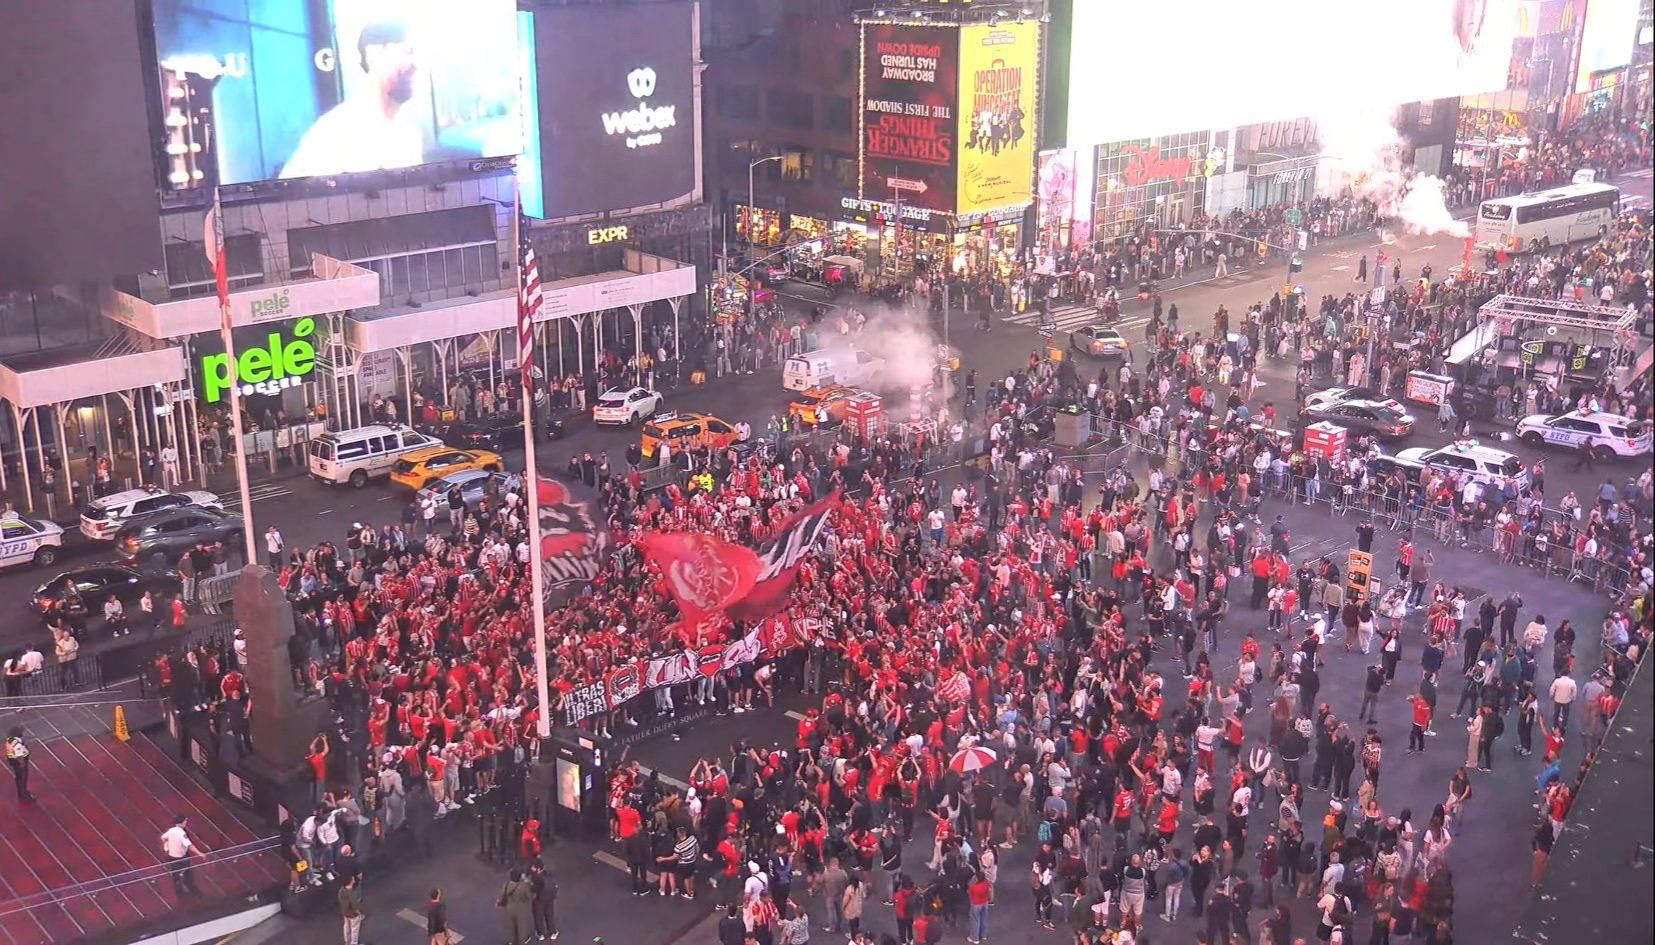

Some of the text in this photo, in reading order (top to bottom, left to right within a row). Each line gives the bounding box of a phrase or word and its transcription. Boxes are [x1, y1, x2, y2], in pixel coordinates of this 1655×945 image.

[881, 55, 936, 70] HAS TURNED
[882, 67, 934, 82] BROADWAY
[974, 66, 1022, 94] OPERATION
[601, 102, 676, 135] webex
[866, 99, 951, 119] THE FIRST SHADOW
[880, 115, 938, 140] THINGS
[867, 127, 951, 162] STRANGER
[1120, 143, 1192, 190] Disney
[841, 197, 871, 211] GIFTS
[588, 225, 628, 244] EXPR
[251, 289, 290, 317] pelé
[203, 318, 316, 403] pelé
[563, 680, 605, 710] ULTRAS
